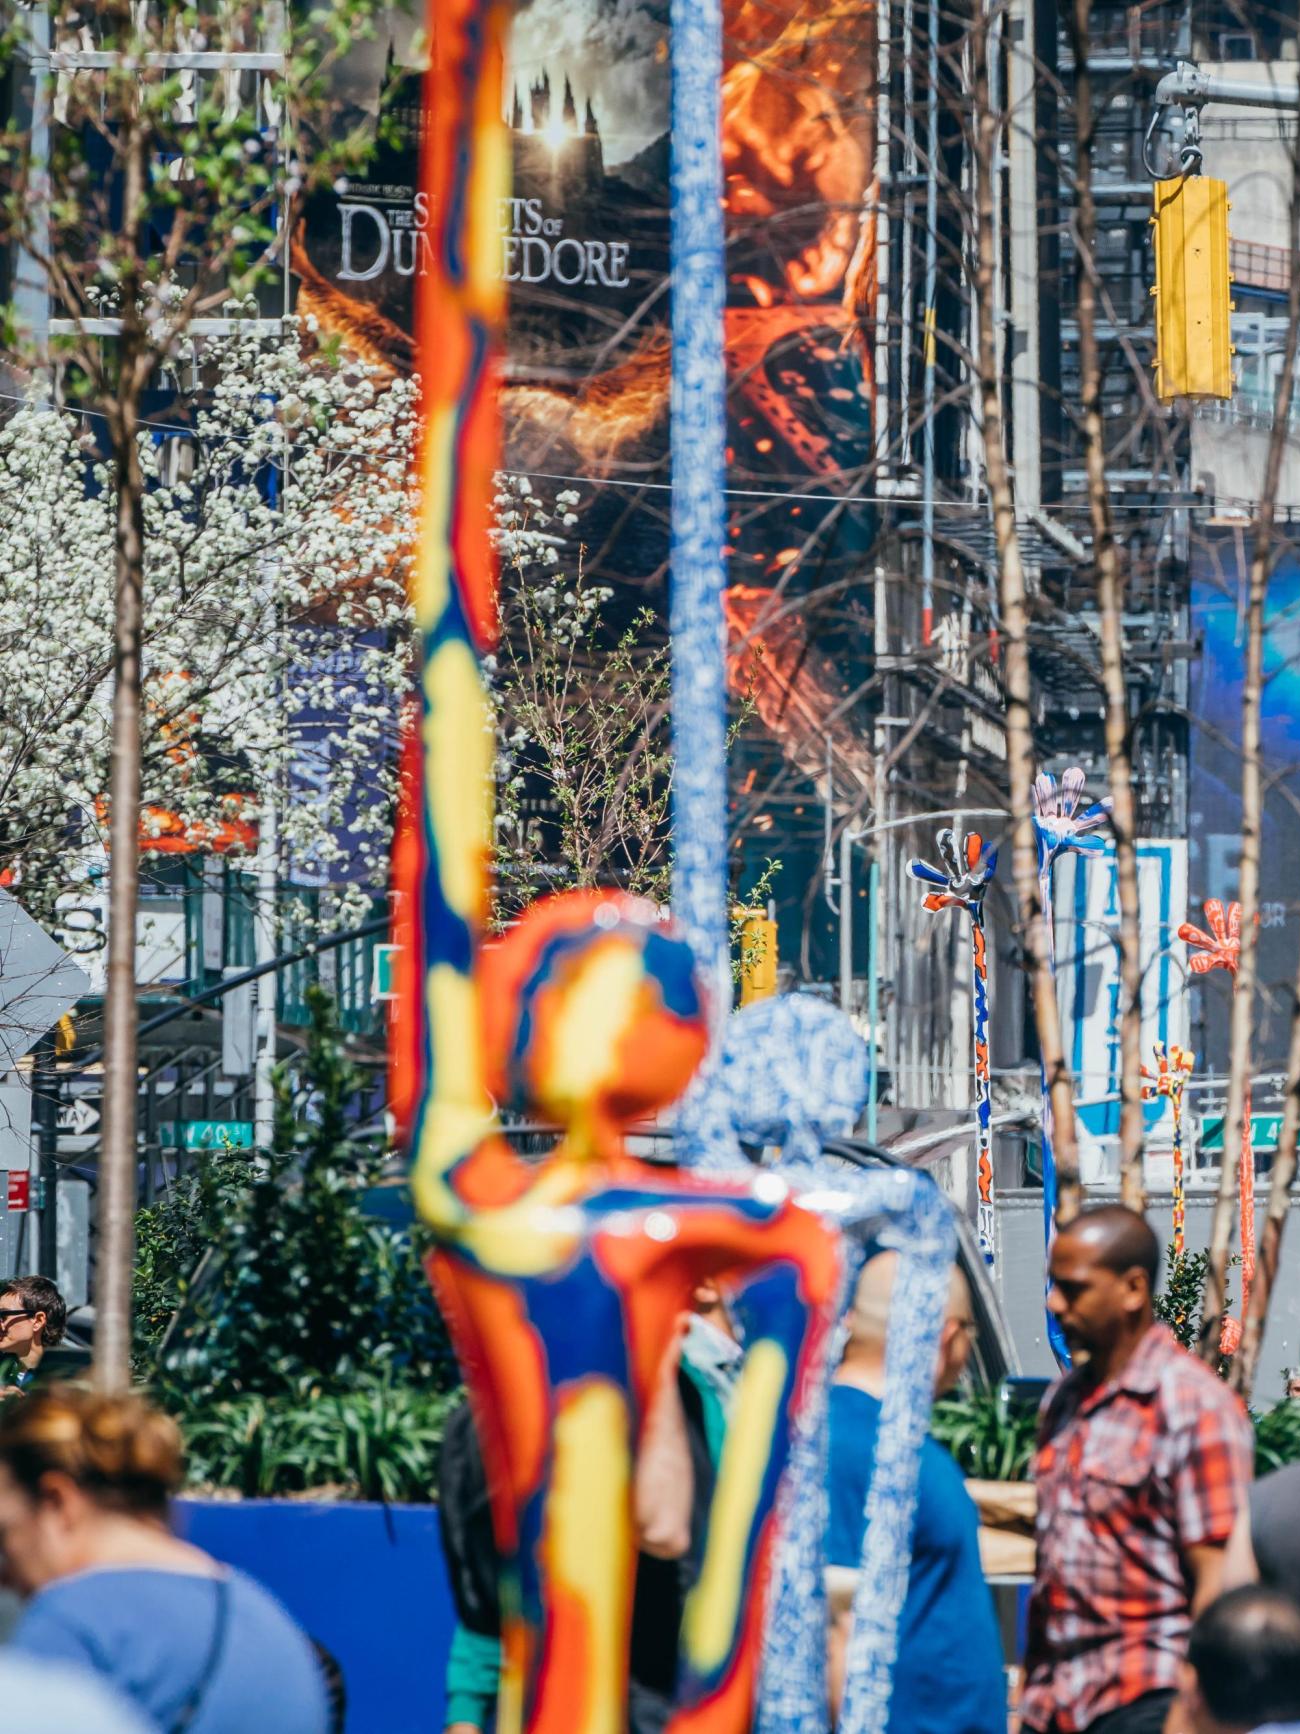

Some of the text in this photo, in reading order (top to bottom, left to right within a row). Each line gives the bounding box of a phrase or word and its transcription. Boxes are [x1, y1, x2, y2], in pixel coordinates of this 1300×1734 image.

[336, 203, 630, 288] DUEDORE
[387, 191, 563, 236] THE SETS OF
